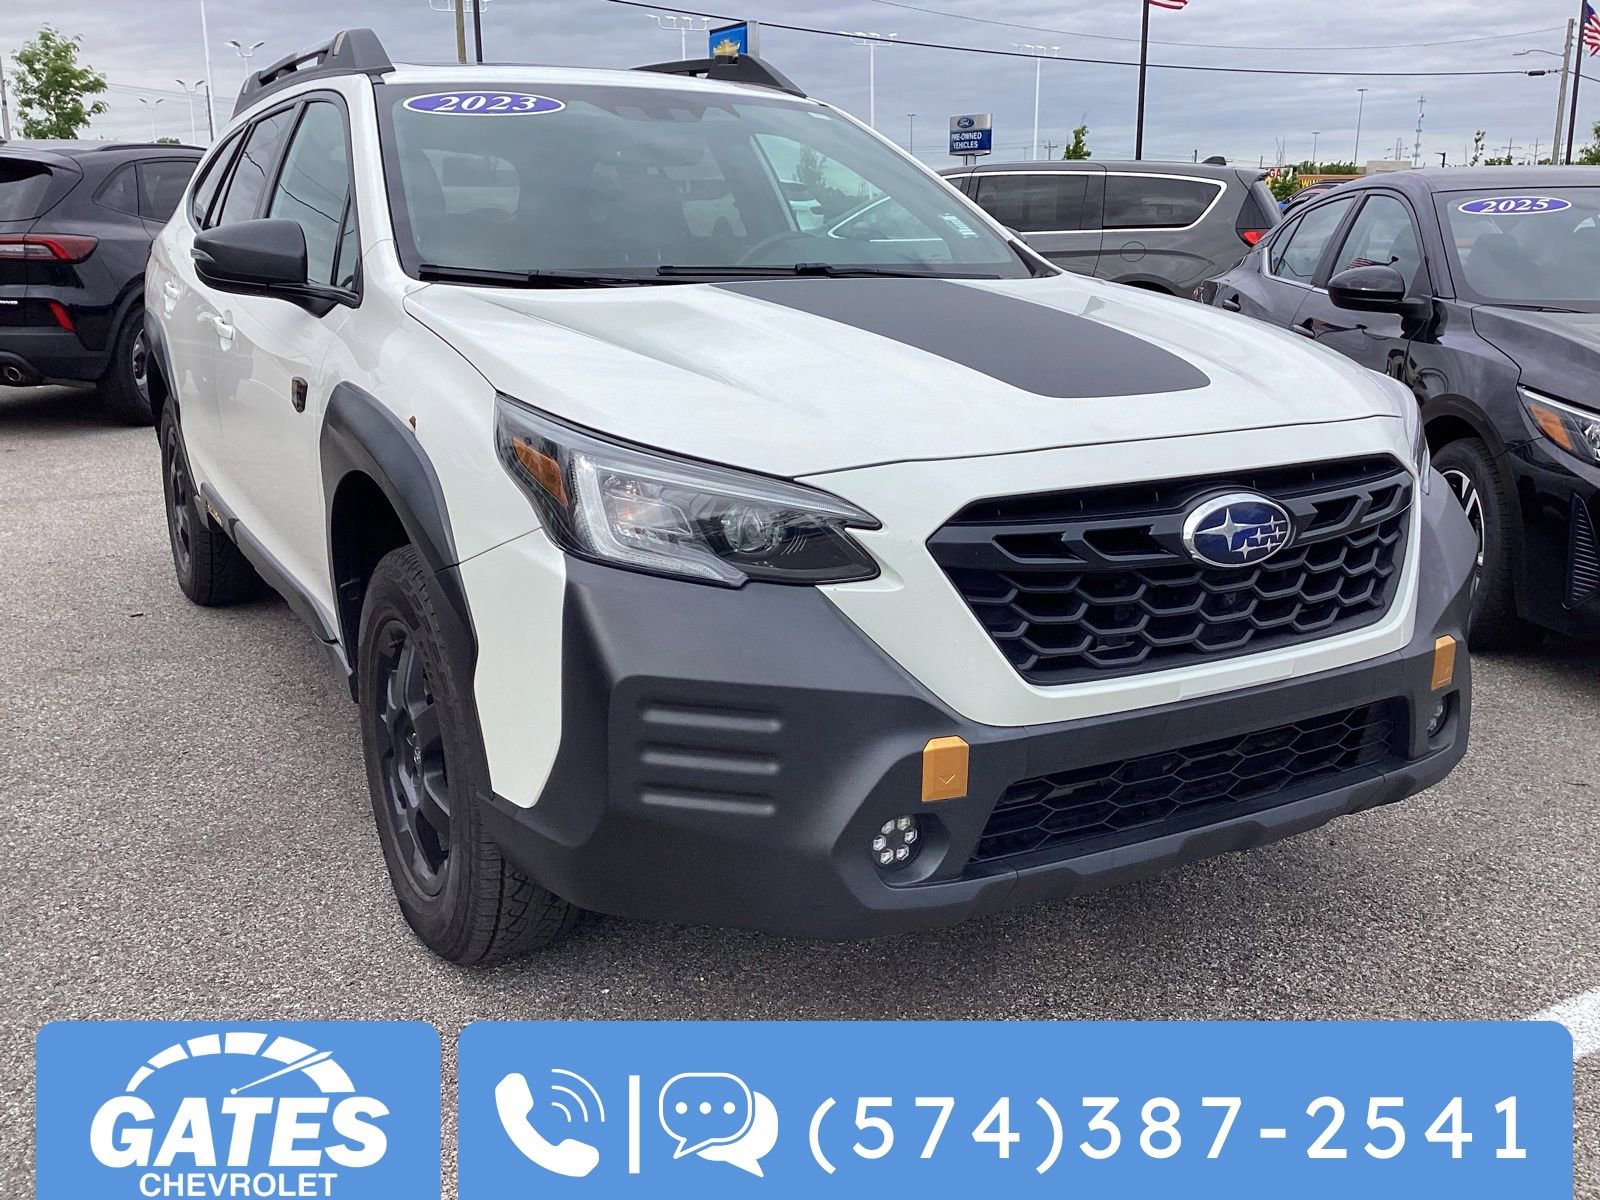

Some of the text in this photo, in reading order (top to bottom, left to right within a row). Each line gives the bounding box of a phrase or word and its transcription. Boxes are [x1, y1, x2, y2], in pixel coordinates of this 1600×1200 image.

[433, 95, 538, 111] 2023
[951, 131, 983, 141] PRE-OWNED
[953, 140, 979, 149] VEHICLES
[1479, 199, 1551, 213] 2025
